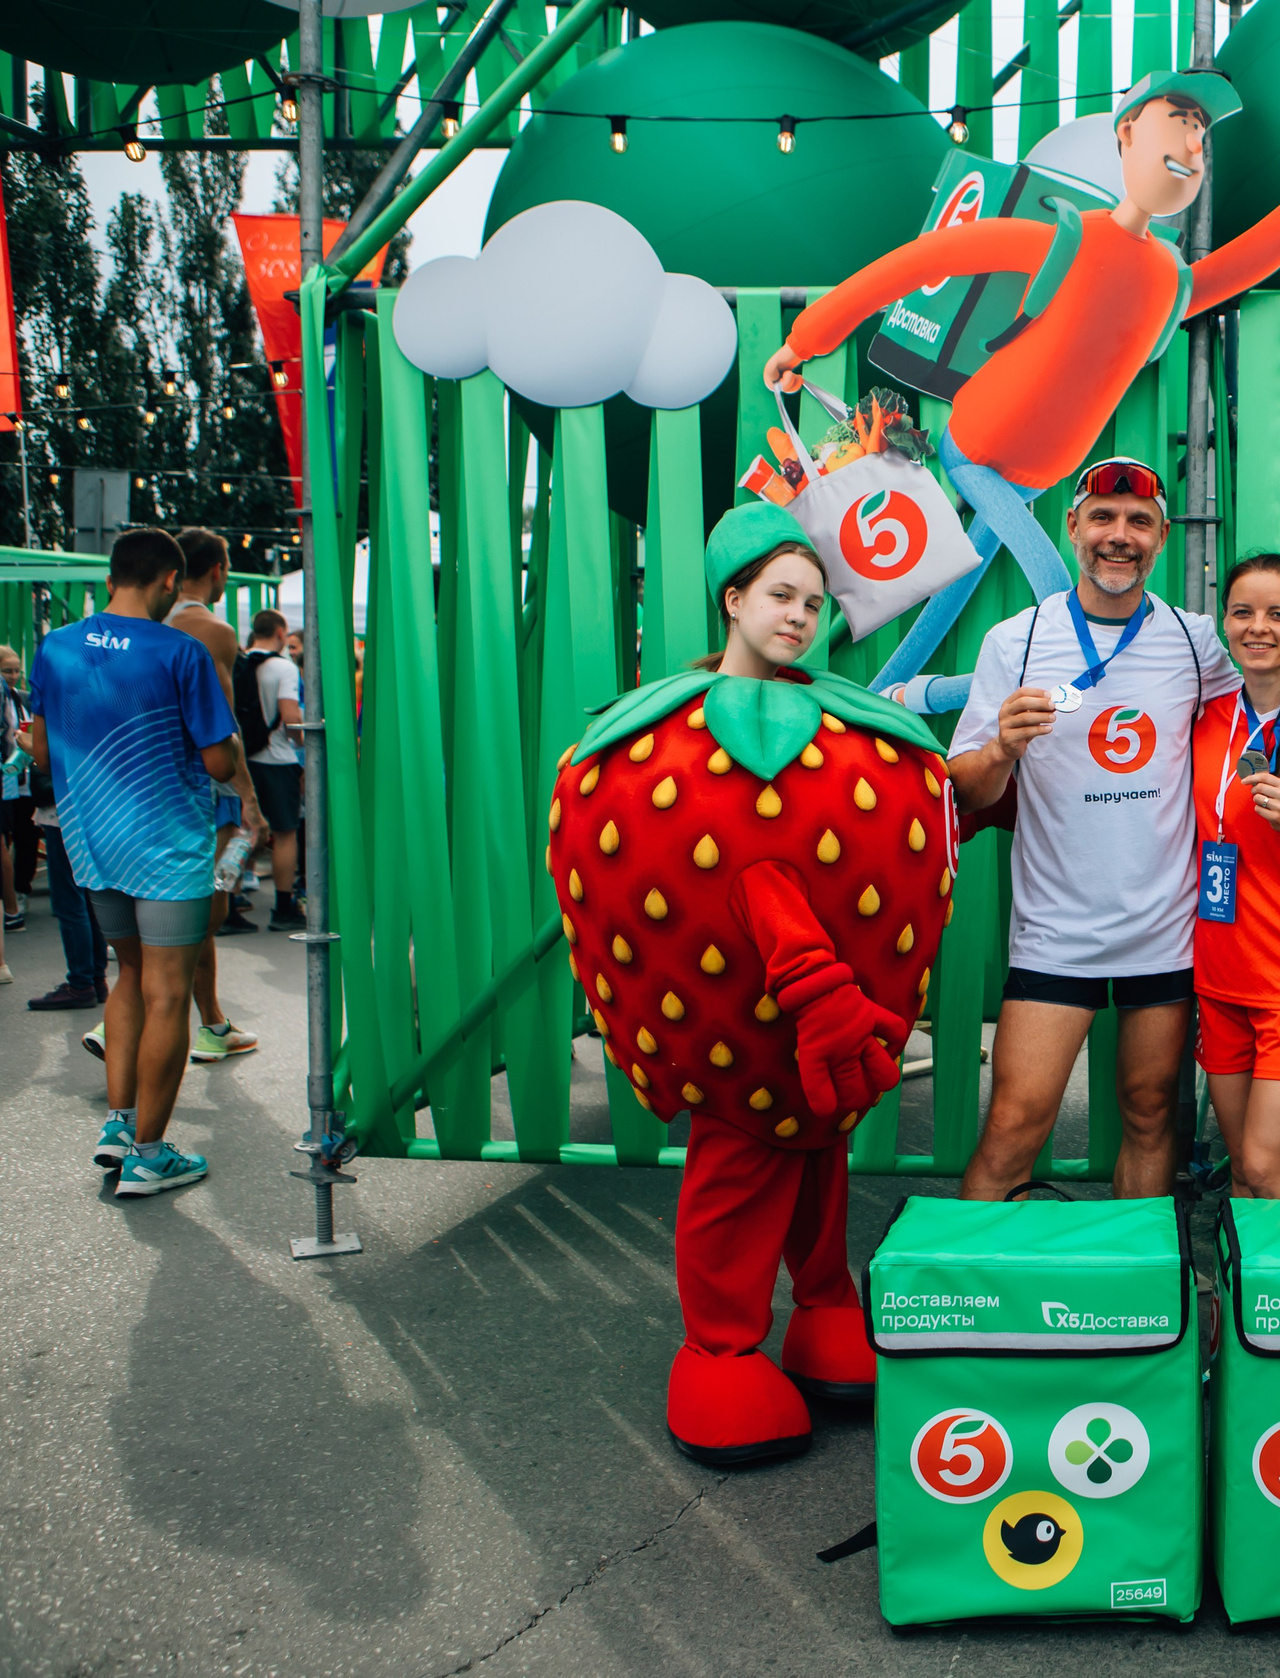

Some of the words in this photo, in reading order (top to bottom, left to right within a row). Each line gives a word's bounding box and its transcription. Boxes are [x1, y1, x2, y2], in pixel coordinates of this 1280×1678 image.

[887, 299, 941, 343] Доставка
[1084, 787, 1161, 804] выручает!
[1206, 865, 1223, 903] 3
[1223, 868, 1231, 905] МЕСТО
[881, 1292, 1000, 1309] Доставляем
[882, 1313, 975, 1330] продукты
[1116, 1586, 1163, 1602] 25649
